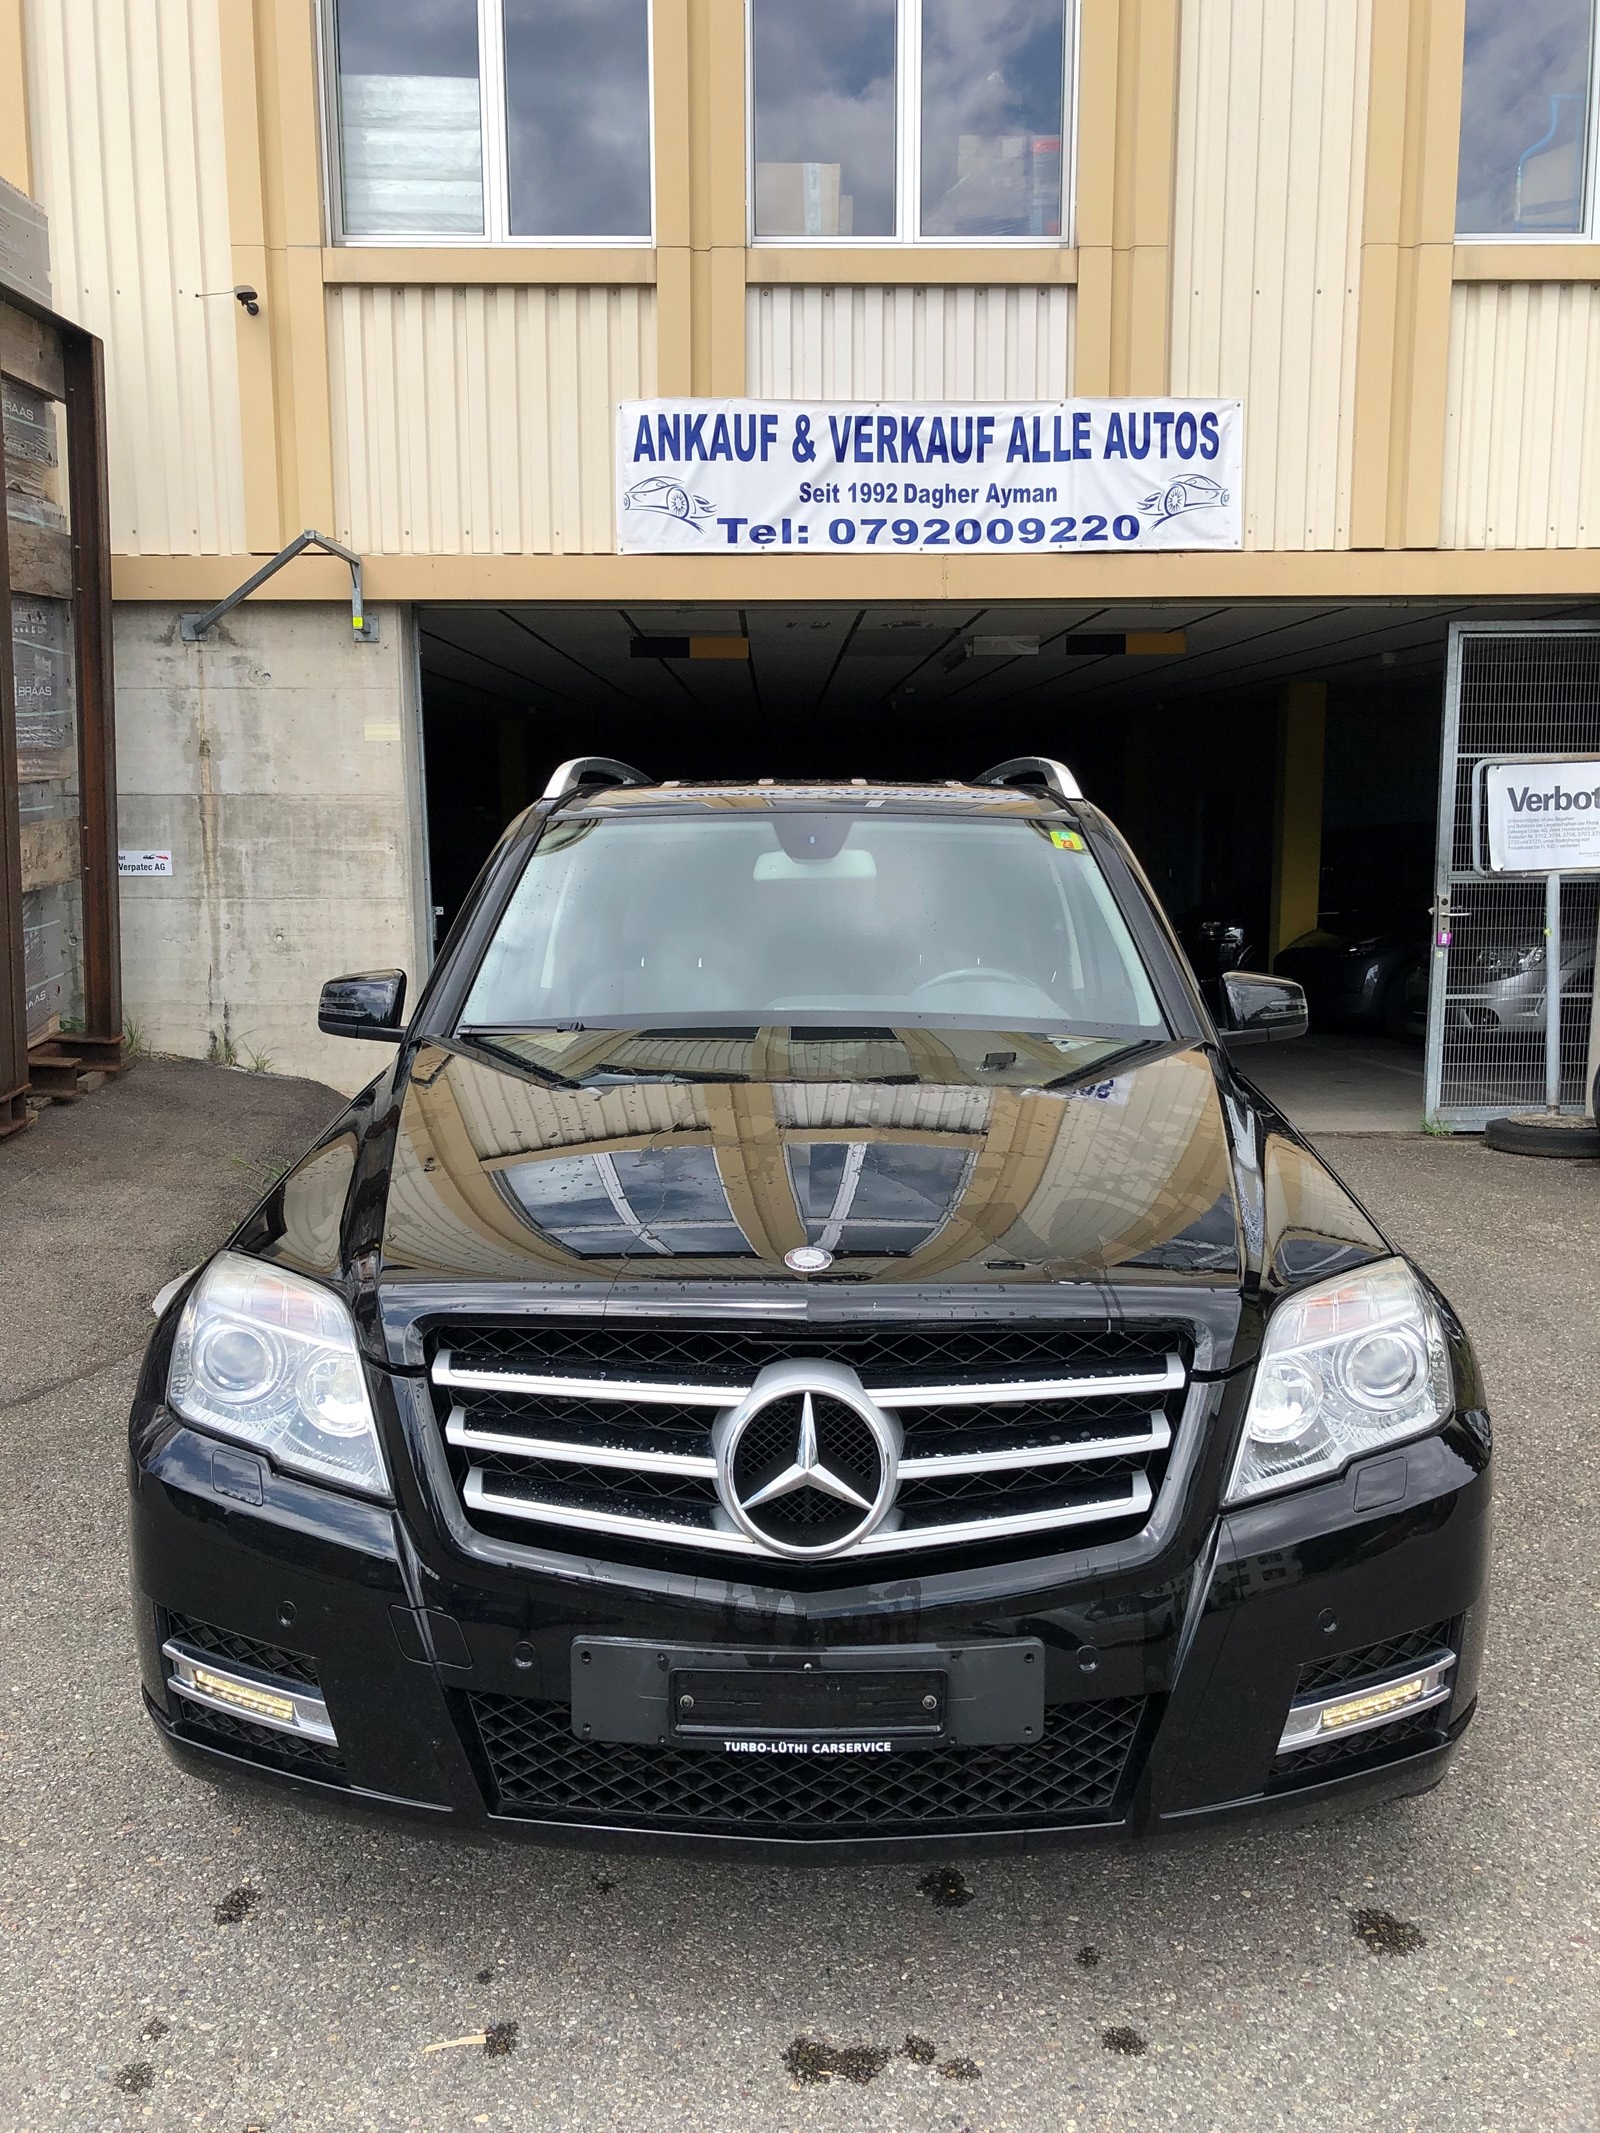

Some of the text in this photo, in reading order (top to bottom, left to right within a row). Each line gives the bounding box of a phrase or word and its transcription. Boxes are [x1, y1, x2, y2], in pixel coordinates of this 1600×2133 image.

[633, 411, 1219, 464] ANKAUF & VERKAUF ALLE AUTOS
[799, 482, 1057, 508] Seit 1992 Dagher Ayman
[716, 514, 1140, 545] Tel: 0792009220
[18, 686, 52, 696] BRAAS
[154, 863, 166, 871] AG
[724, 1741, 891, 1754] TURBO-LÜTHI CARSERVICE
